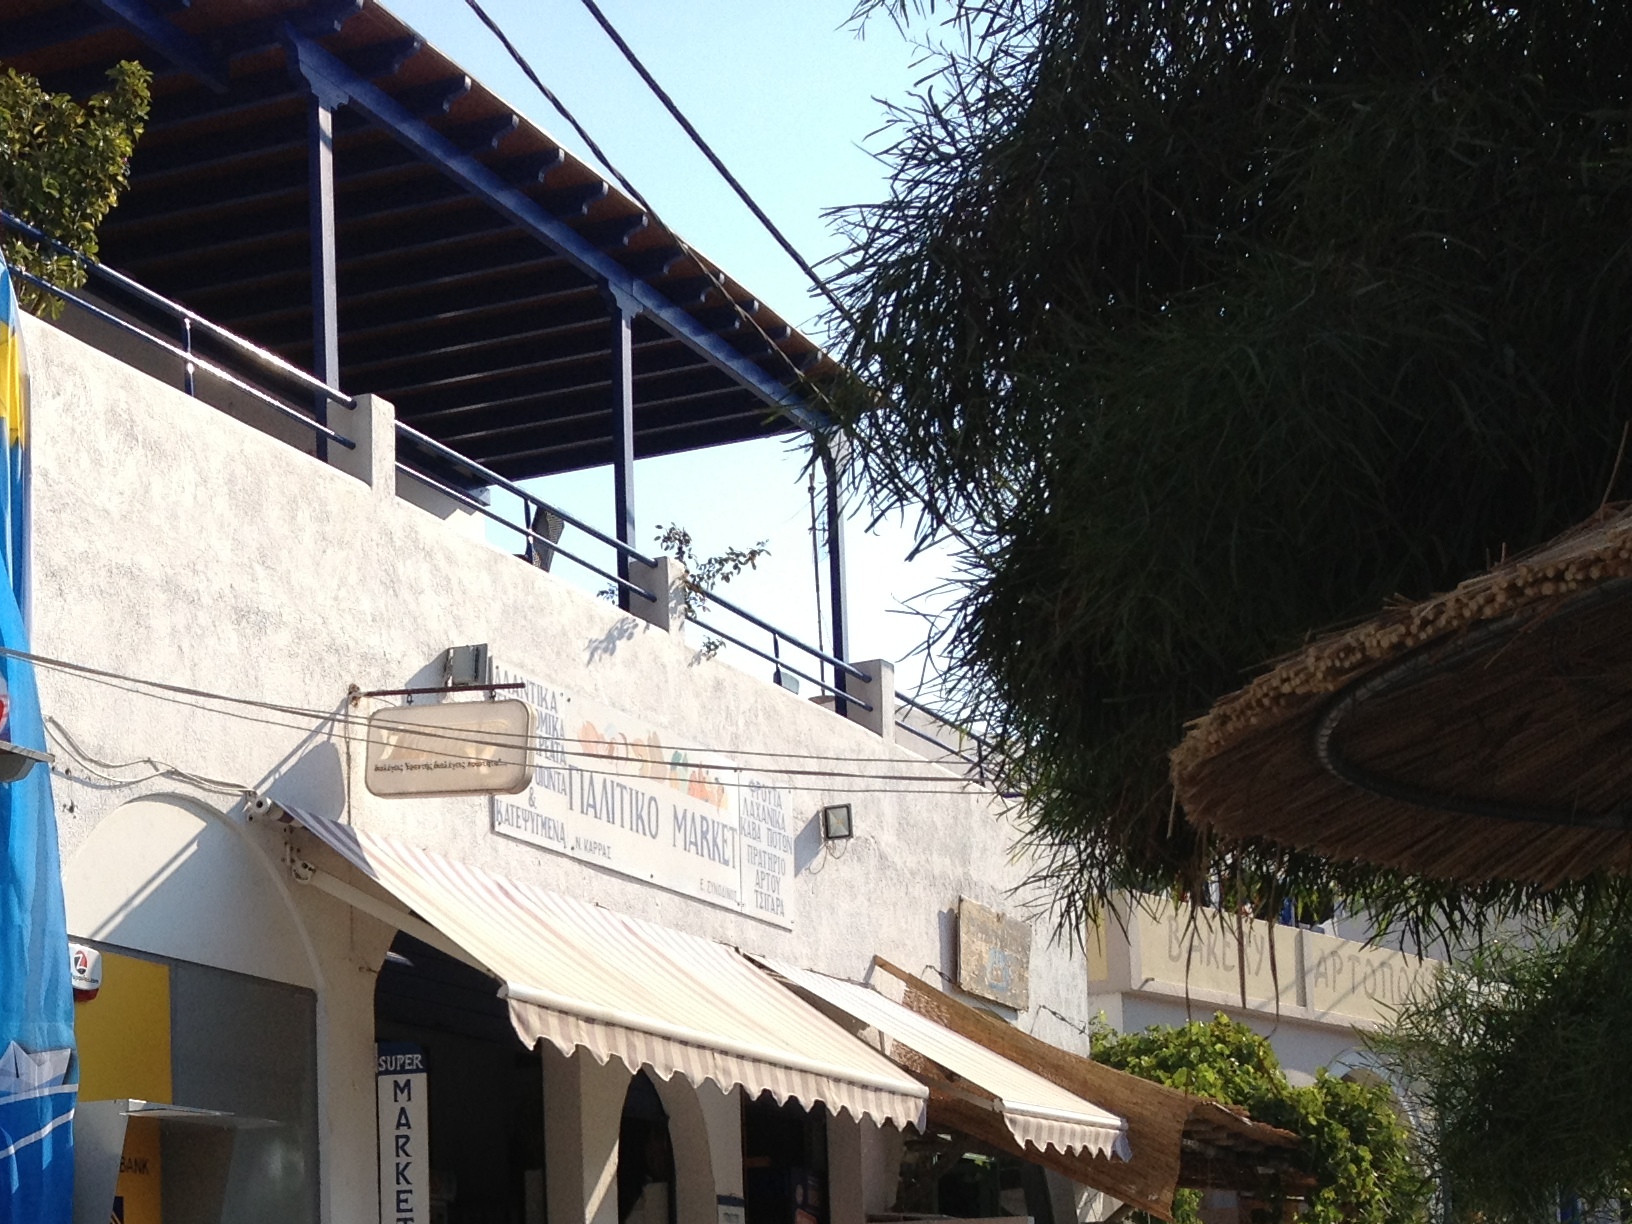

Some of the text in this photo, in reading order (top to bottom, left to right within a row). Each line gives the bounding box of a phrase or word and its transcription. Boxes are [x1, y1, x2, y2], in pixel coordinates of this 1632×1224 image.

[496, 798, 567, 849] ΚΑΤΕΨΥΓΜΕΝΑ
[740, 816, 762, 842] ΚΑΒΑ
[742, 797, 786, 833] ΛΑΧΑΝΙΚΑ
[672, 804, 738, 870] MARKET
[747, 844, 786, 876] ΠΡΑΤΗΡΙΟ
[755, 869, 781, 895] ΑΡΤΟΥ
[378, 1053, 423, 1073] SUPER
